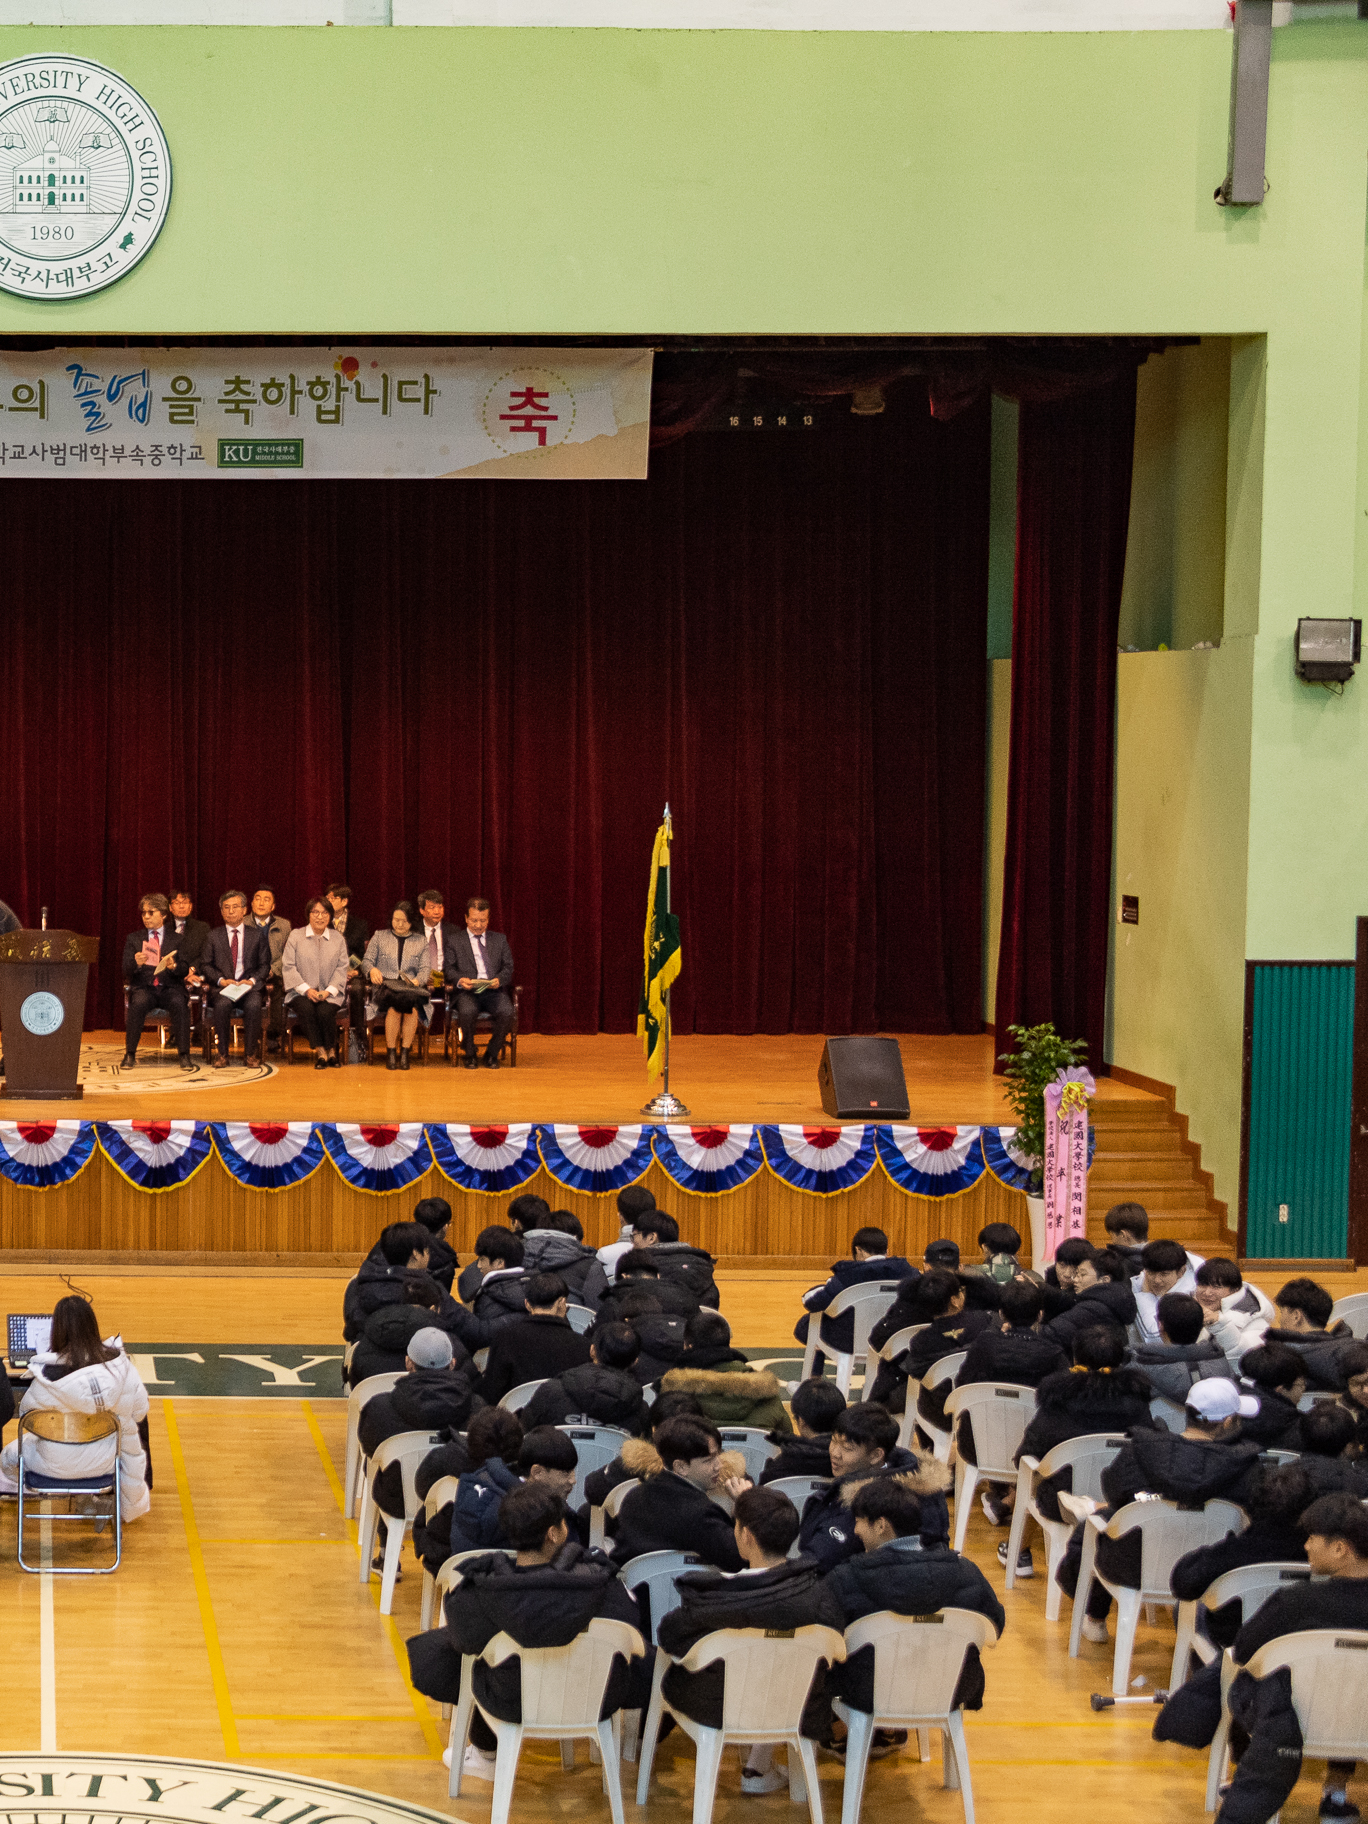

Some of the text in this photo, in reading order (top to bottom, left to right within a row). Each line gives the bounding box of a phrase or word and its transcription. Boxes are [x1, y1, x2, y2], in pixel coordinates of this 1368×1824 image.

[94, 84, 144, 134] HIGH
[132, 137, 160, 225] SCHOOL
[29, 225, 75, 241] 1980
[216, 372, 439, 427] 축하합니다
[498, 386, 559, 447] 축
[729, 415, 813, 426] 16 15 14 13
[223, 445, 253, 461] KU
